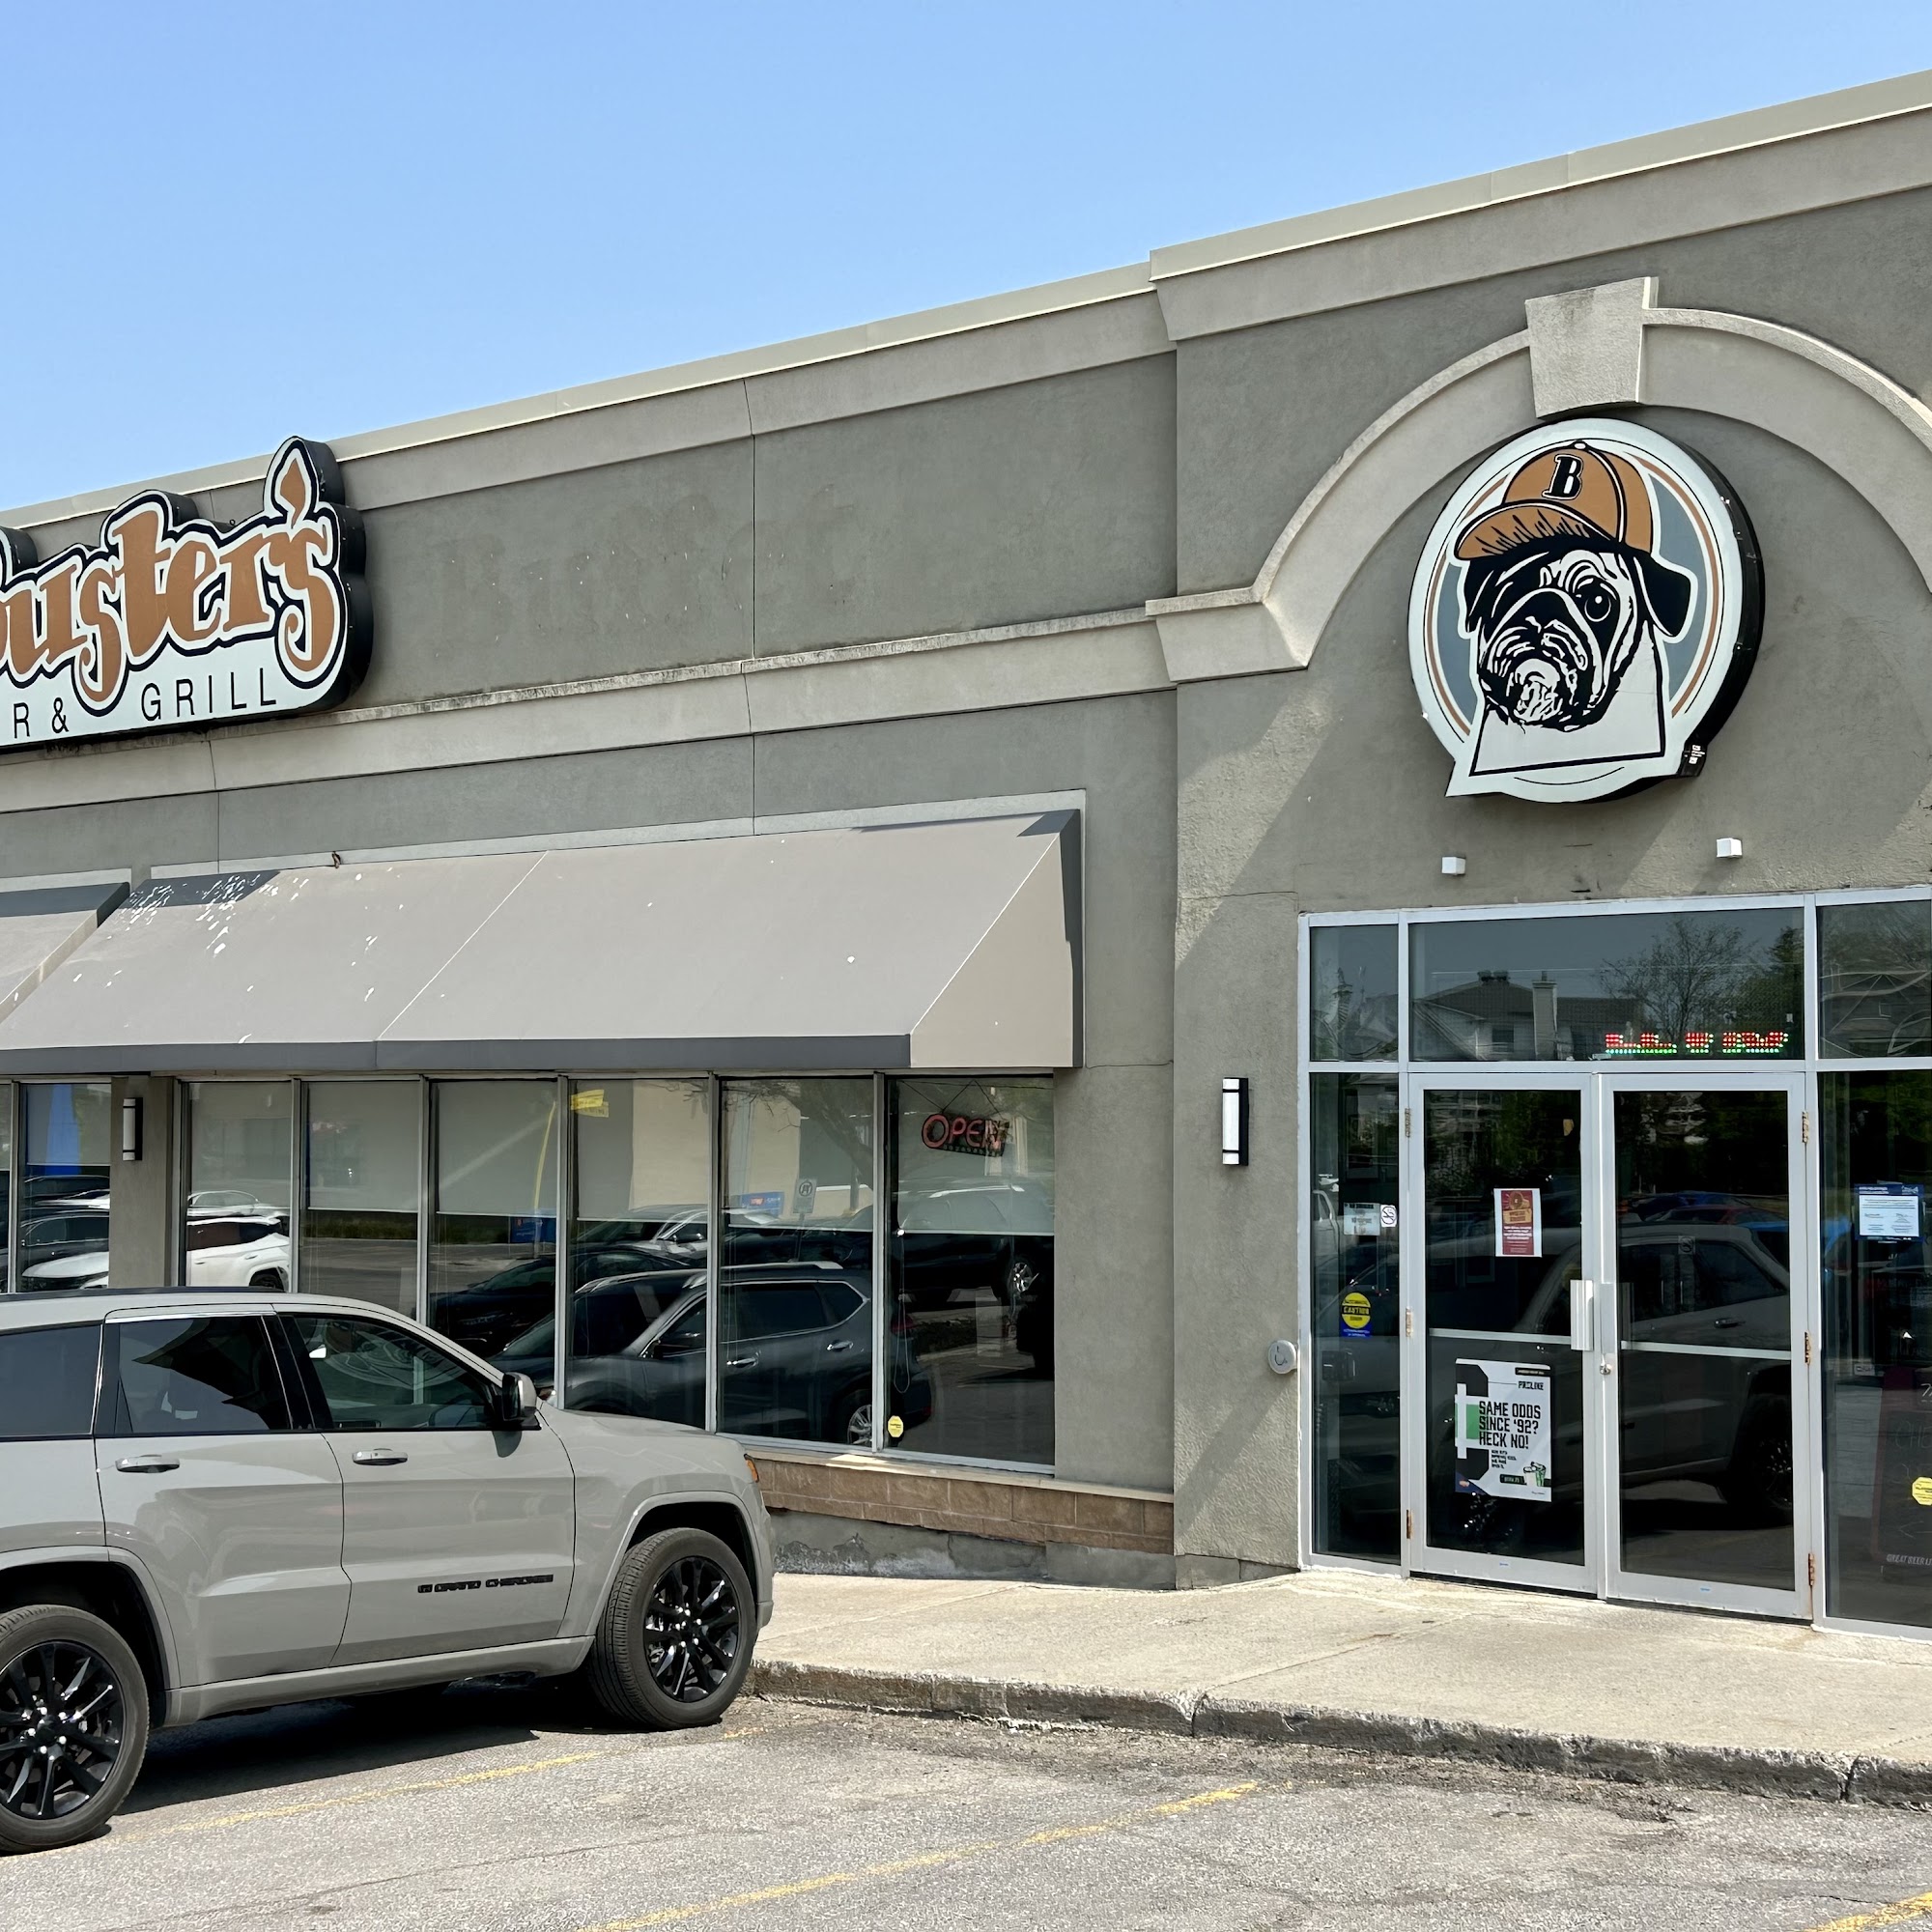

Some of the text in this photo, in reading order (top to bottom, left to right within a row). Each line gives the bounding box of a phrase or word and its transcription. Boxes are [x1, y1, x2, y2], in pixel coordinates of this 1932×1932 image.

[51, 696, 70, 734] &
[141, 668, 276, 722] GRILL
[922, 1113, 1009, 1151] OPEN
[1479, 1401, 1541, 1419] SAME ODDS
[1479, 1416, 1510, 1432] SINCE
[1479, 1432, 1529, 1449] HECK NO!
